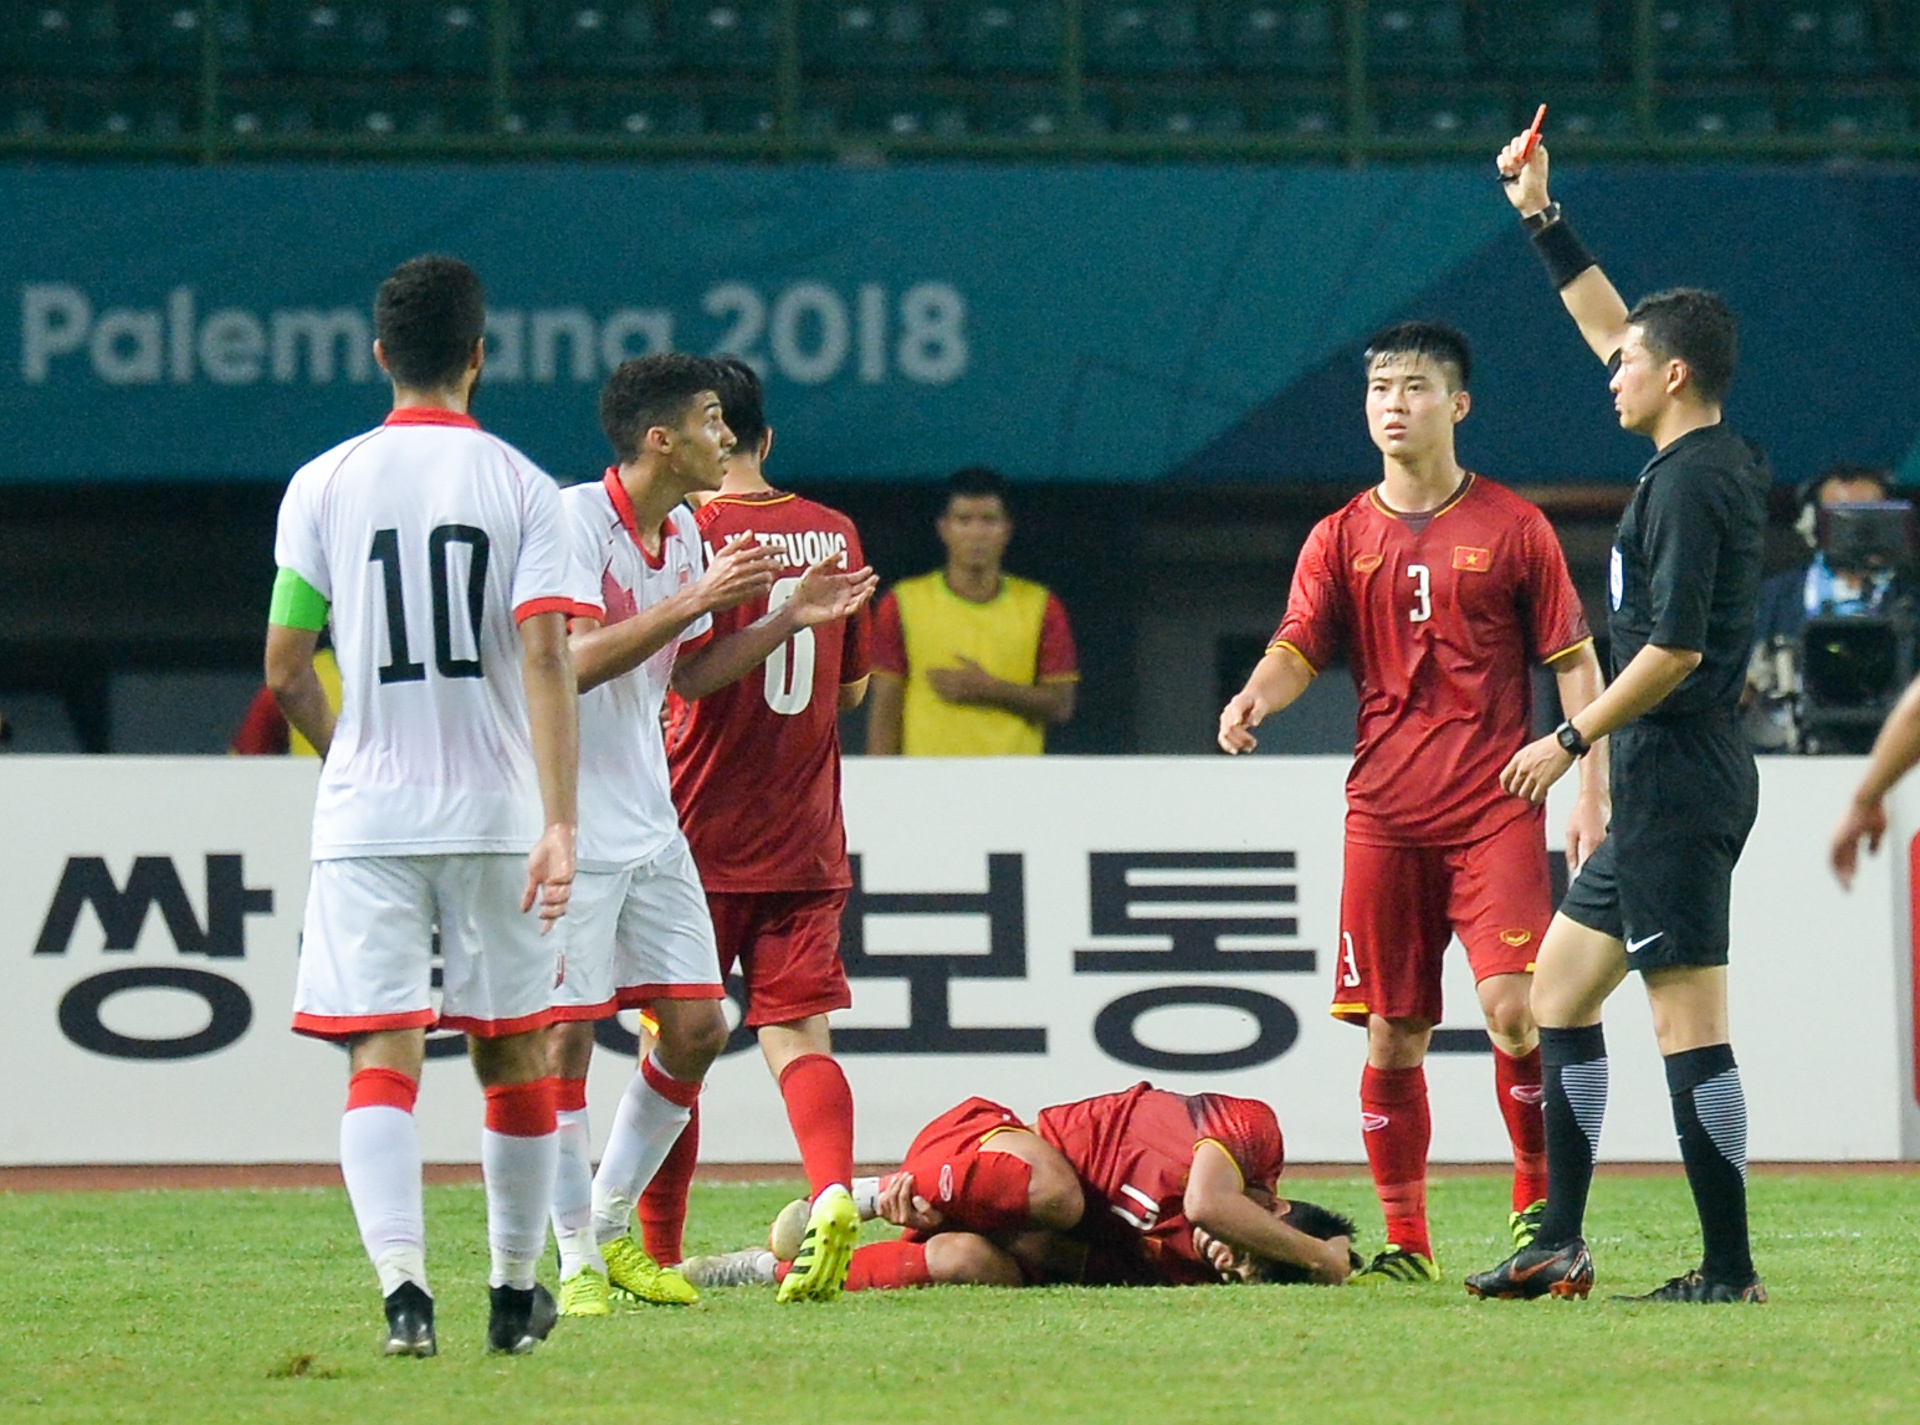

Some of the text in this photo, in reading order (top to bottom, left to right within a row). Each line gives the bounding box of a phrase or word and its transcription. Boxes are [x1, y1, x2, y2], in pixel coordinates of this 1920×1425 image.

[22, 283, 968, 384] Palemang 2018
[368, 524, 490, 685] 10
[1407, 564, 1432, 622] 3
